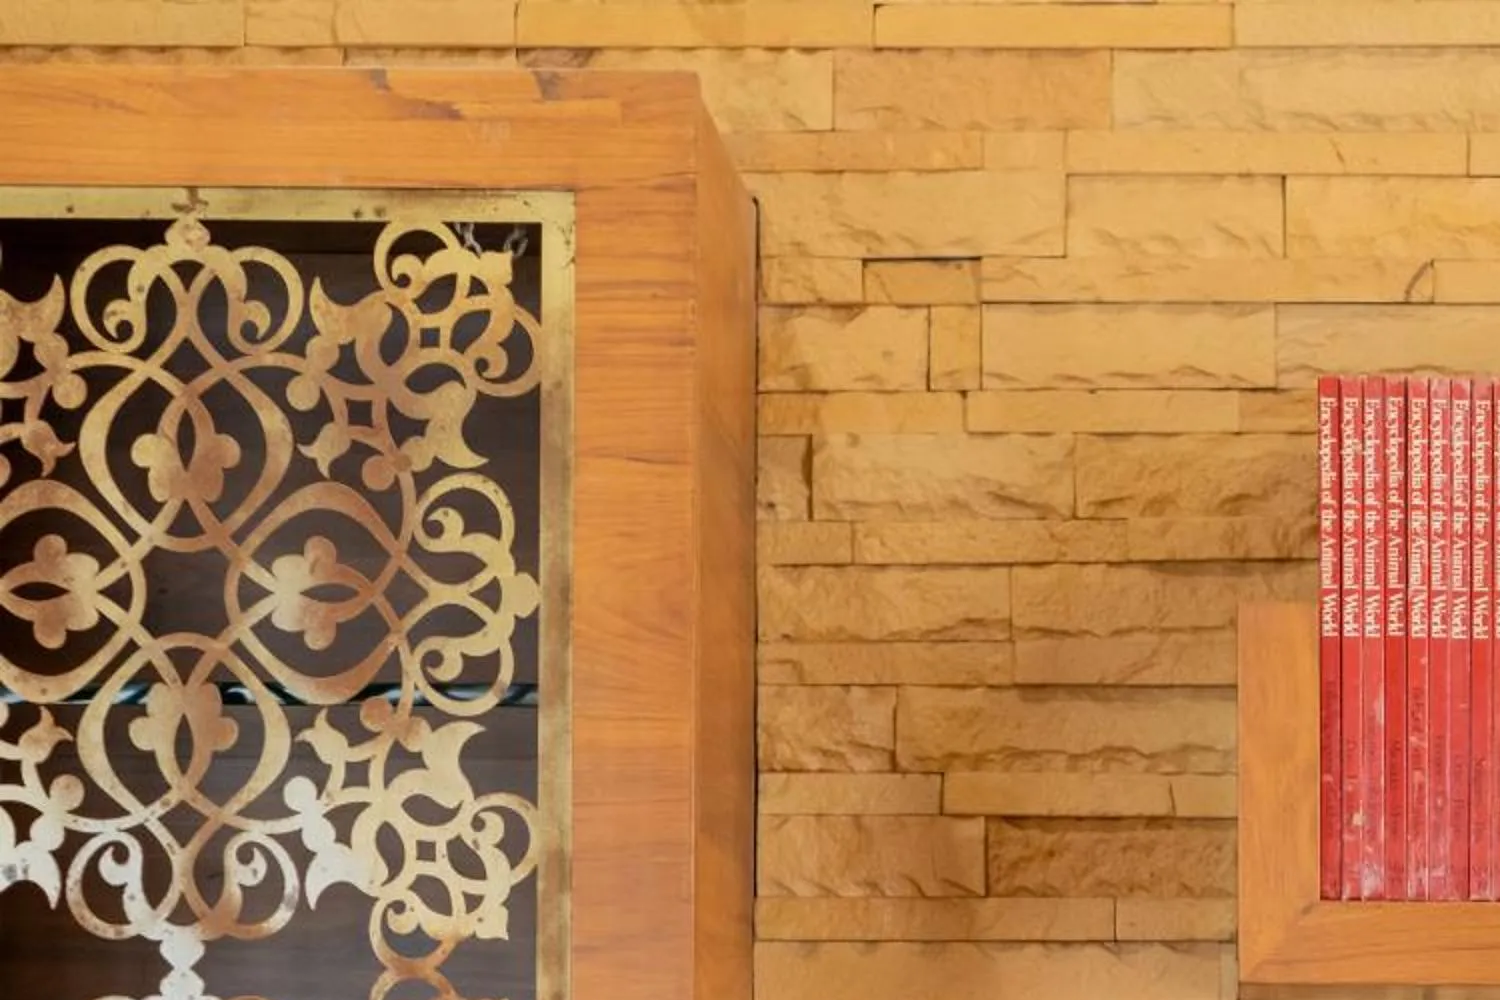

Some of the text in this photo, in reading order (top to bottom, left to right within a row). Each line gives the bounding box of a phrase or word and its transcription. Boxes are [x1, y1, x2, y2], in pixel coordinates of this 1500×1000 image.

[1322, 491, 1339, 505] of
[1344, 491, 1359, 505] of
[1365, 492, 1380, 507] of
[1432, 493, 1447, 506] of
[1322, 508, 1339, 532] the
[1344, 508, 1359, 532] the
[1365, 511, 1380, 533] the
[1432, 511, 1447, 533] the
[1322, 536, 1339, 589] Animal
[1344, 536, 1359, 589] Animal
[1365, 536, 1380, 590] Animal
[1432, 536, 1447, 590] Animal
[1322, 593, 1339, 637] World
[1344, 593, 1359, 637] World
[1365, 594, 1380, 637] World
[1432, 595, 1447, 638] World
